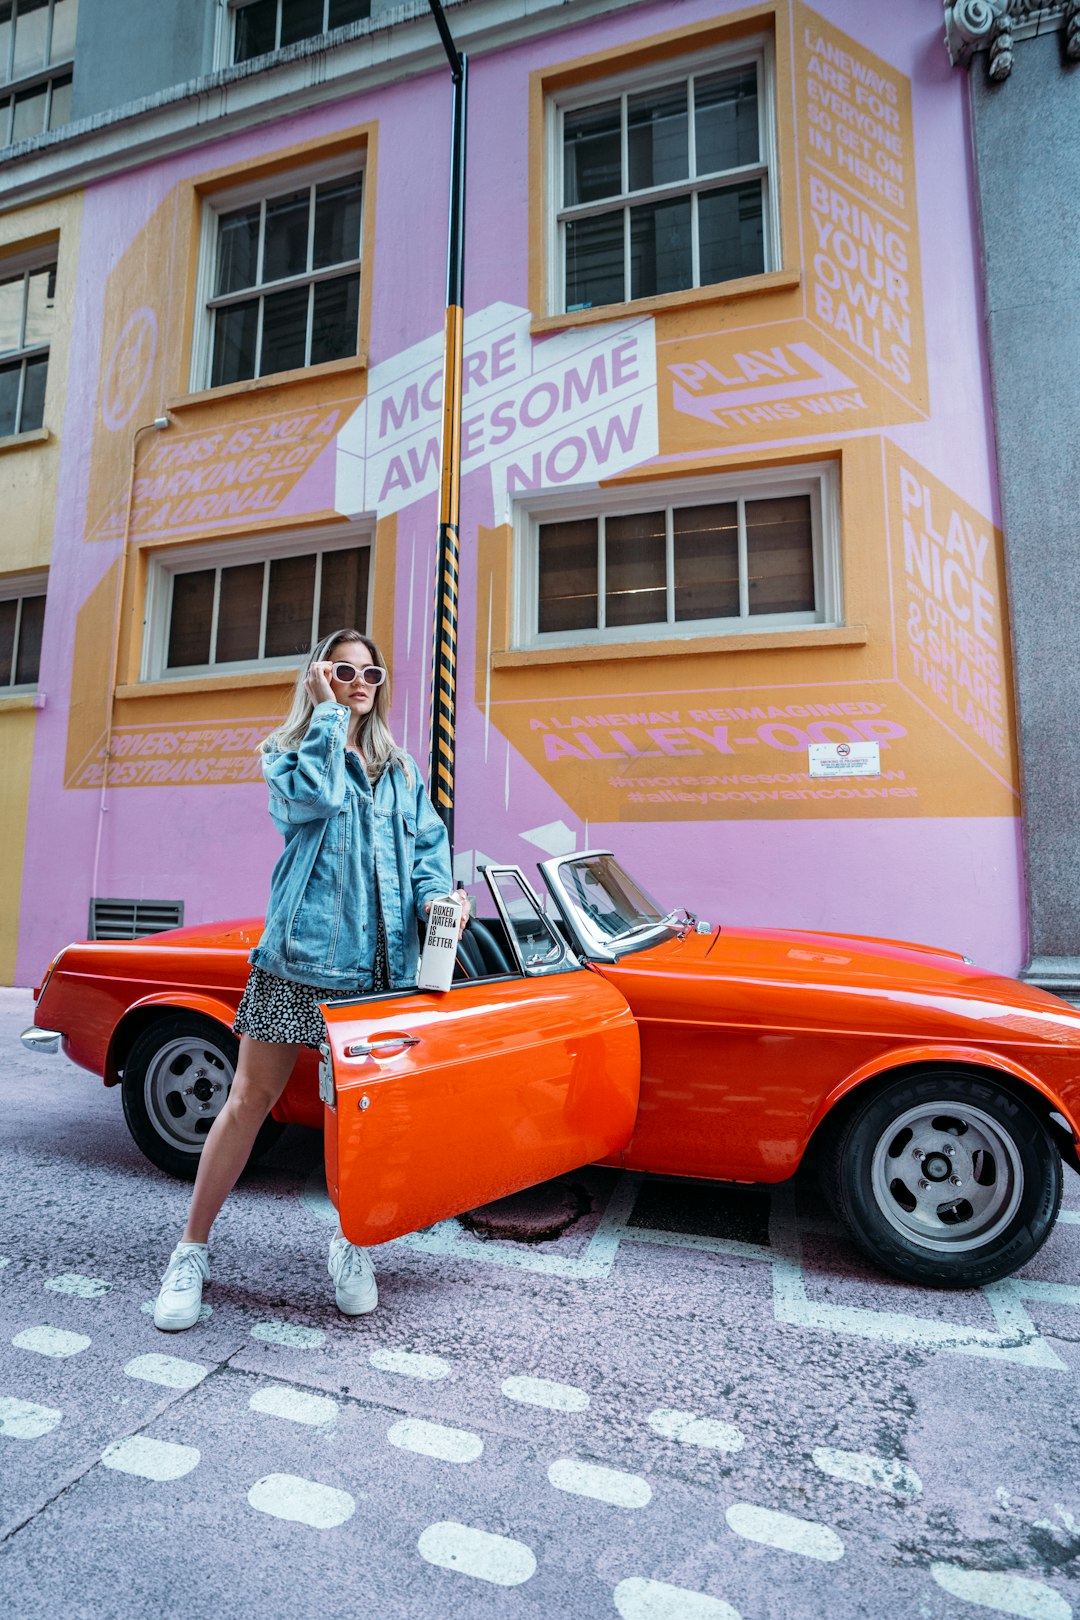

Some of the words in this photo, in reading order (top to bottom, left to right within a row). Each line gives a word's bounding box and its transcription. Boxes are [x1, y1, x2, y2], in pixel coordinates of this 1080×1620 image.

[805, 26, 897, 105] LANEWAYS
[808, 55, 850, 98] ARE
[855, 85, 900, 131] FOR
[807, 77, 903, 158] EVERYONE
[808, 102, 832, 132] SO
[836, 122, 872, 159] GET
[875, 151, 903, 183] ON
[809, 127, 832, 158] IN
[837, 145, 905, 209] HERE!
[810, 174, 908, 271] BRING
[810, 210, 910, 313] YOUR
[813, 253, 911, 348] OWN
[815, 282, 911, 385] BALLS
[379, 332, 516, 439] MORE
[666, 346, 800, 390] PLAY
[149, 434, 225, 471] THIS
[220, 427, 261, 456] IS
[260, 413, 320, 442] NOT
[307, 409, 340, 439] A
[377, 337, 639, 503] AWESOME
[506, 403, 643, 492] NOW
[720, 403, 802, 426] THIS
[797, 392, 869, 415] WAY
[120, 453, 272, 505] PARKING
[269, 443, 322, 469] LOT
[143, 502, 171, 529] A
[169, 481, 284, 525] URINAL
[900, 465, 989, 582] PLAY
[903, 516, 997, 652] NICE
[925, 596, 1000, 686] OTHERS
[927, 628, 1003, 725] SHARE
[529, 718, 550, 731] A
[550, 710, 681, 729] LANEWAY
[542, 719, 908, 761] ALLEY-OOP
[908, 643, 949, 705] THE
[951, 684, 1006, 760] LANE
[75, 757, 216, 785] PEDESTRIANS
[96, 731, 186, 758] DRIVERS
[627, 787, 918, 805] #alleyoopvancouver
[427, 936, 454, 949] BETTER.
[429, 925, 437, 936] IS
[431, 915, 453, 928] WATER
[432, 904, 454, 917] BOXED
[889, 1079, 1020, 1117] NEXEN
